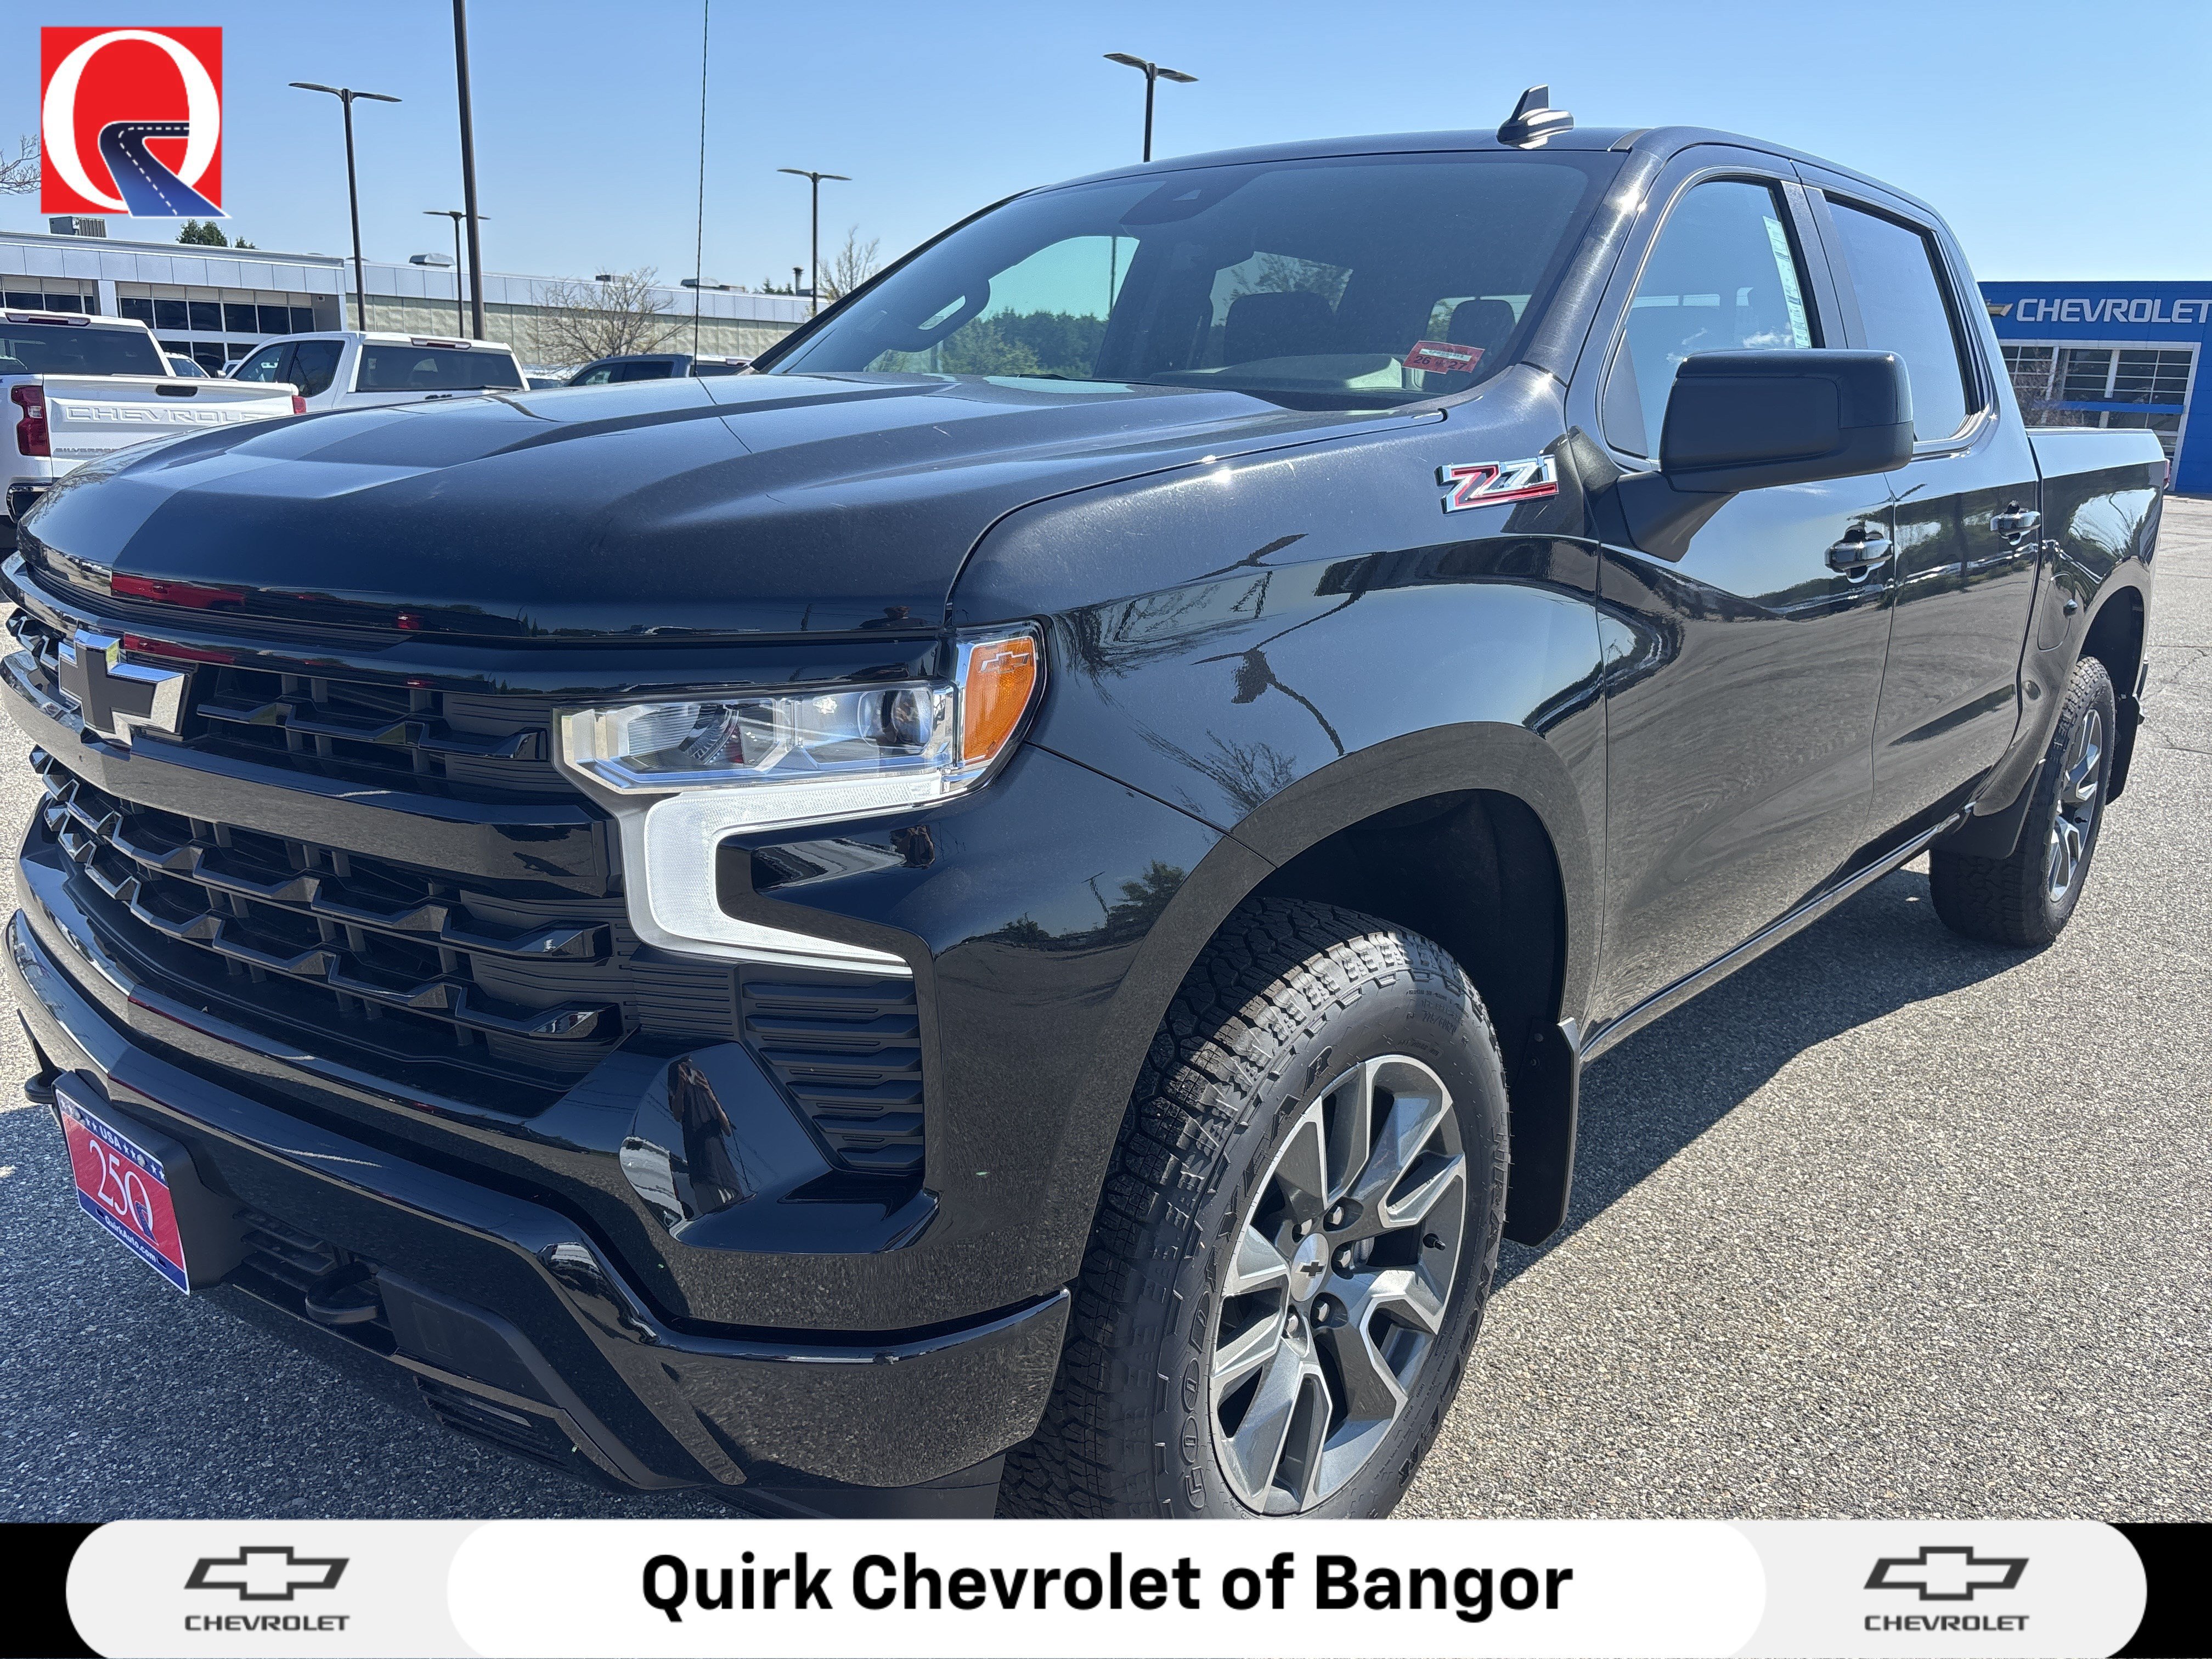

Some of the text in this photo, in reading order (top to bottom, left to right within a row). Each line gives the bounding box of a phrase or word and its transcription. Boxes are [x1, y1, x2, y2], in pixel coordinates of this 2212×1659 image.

[2016, 298, 2212, 324] CHEVROLET
[1413, 356, 1468, 370] 26 27
[66, 407, 277, 422] CHEVROLE
[1434, 454, 1559, 514] Z71
[99, 1125, 122, 1151] USA
[104, 1215, 157, 1263] QuirkAuto.com
